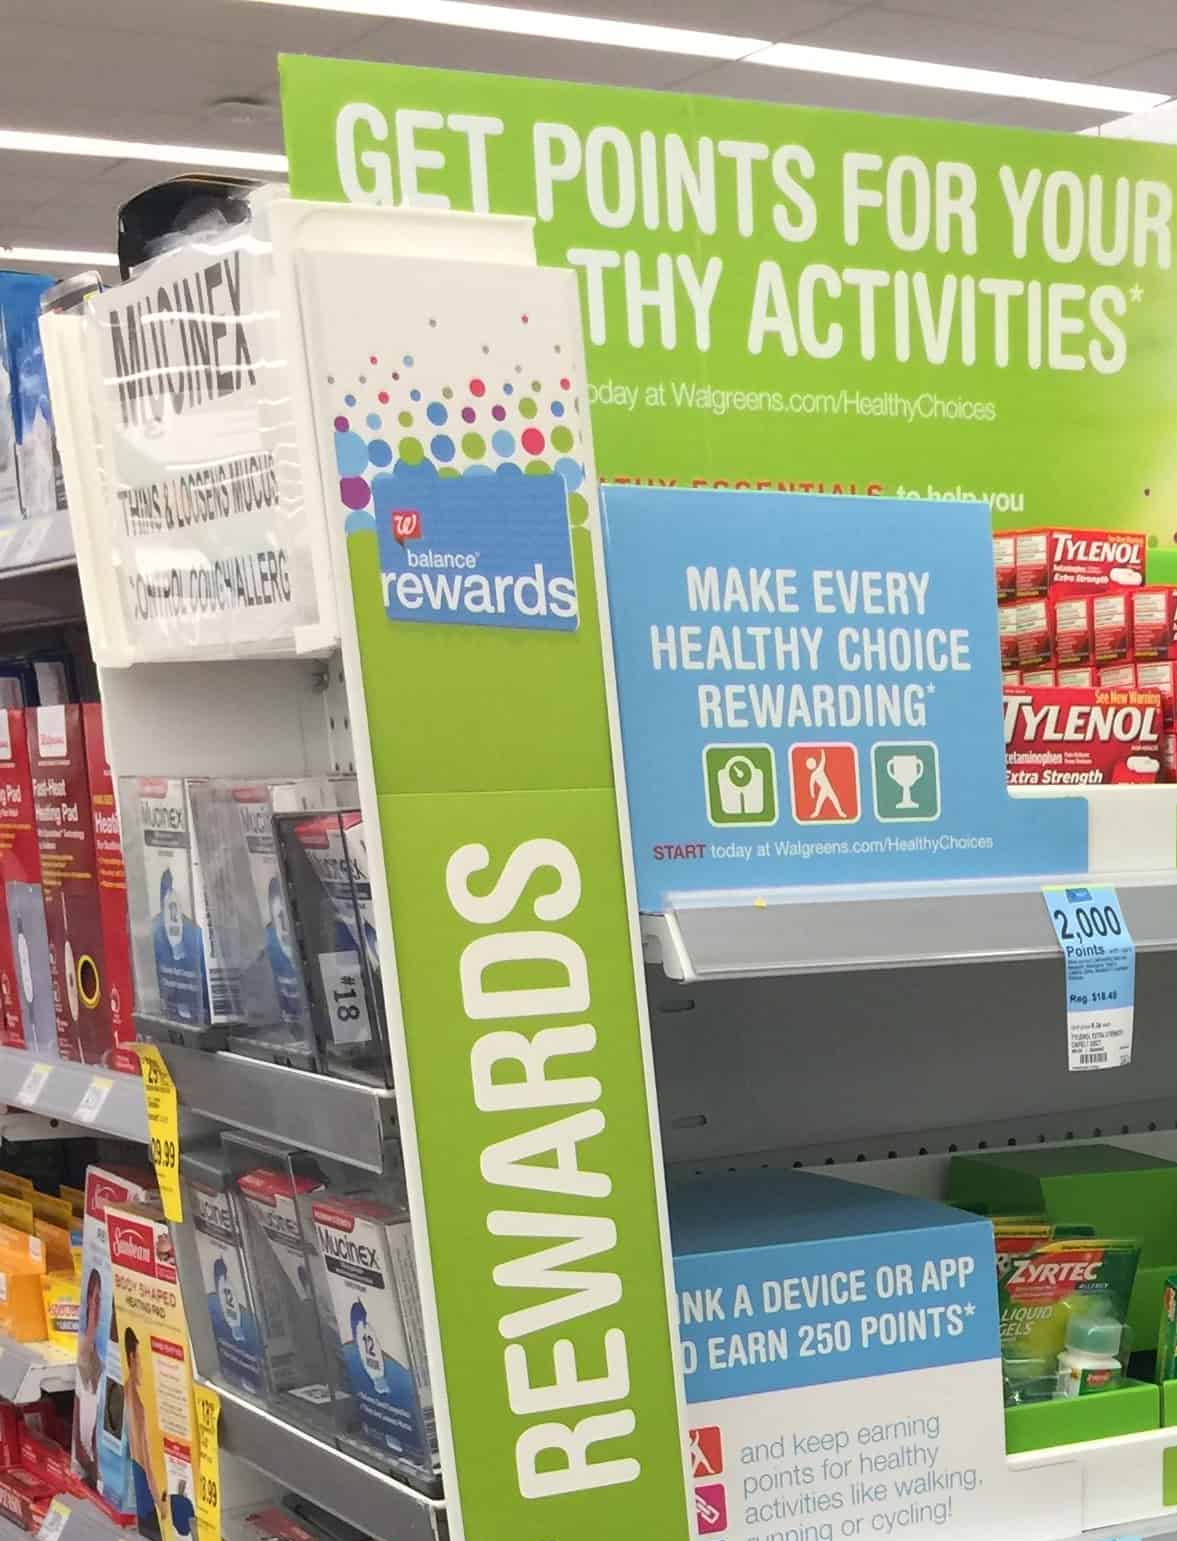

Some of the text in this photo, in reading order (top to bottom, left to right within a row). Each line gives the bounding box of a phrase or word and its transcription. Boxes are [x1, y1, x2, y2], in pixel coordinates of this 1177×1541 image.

[336, 102, 1173, 270] GET POINTS FOR YOUR
[110, 251, 256, 430] MUCINEX
[645, 383, 666, 407] at
[671, 381, 996, 422] Walgreens.com/HealthyChoices
[1053, 534, 1142, 564] TYLENOL
[381, 564, 577, 619] rewards
[686, 566, 929, 615] MAKE EVERY
[650, 625, 971, 672] HEALTHY CHOICE
[1003, 695, 1159, 744] TYLENOL
[1042, 769, 1103, 784] Strength
[653, 834, 994, 863] START today at Walgreens.com/HealthyChoices
[1054, 906, 1121, 944] 2,000
[1066, 945, 1104, 957] Points
[446, 837, 636, 1500] REWARDS
[320, 1228, 379, 1268] Mucinex
[734, 1283, 754, 1318] A
[763, 1270, 866, 1314] DEVICE
[876, 1264, 912, 1296] OR
[921, 1256, 975, 1294] APP
[1008, 1260, 1103, 1284] ZYRTEC
[1001, 1306, 1052, 1321] LIQUID
[708, 1327, 788, 1371] EARN
[798, 1320, 851, 1358] 250
[740, 1414, 941, 1464] and keep earning
[743, 1443, 939, 1499] points for healthy
[745, 1493, 843, 1525] activities
[851, 1480, 887, 1507] like
[841, 1519, 863, 1538] or
[871, 1497, 953, 1533] cycling!
